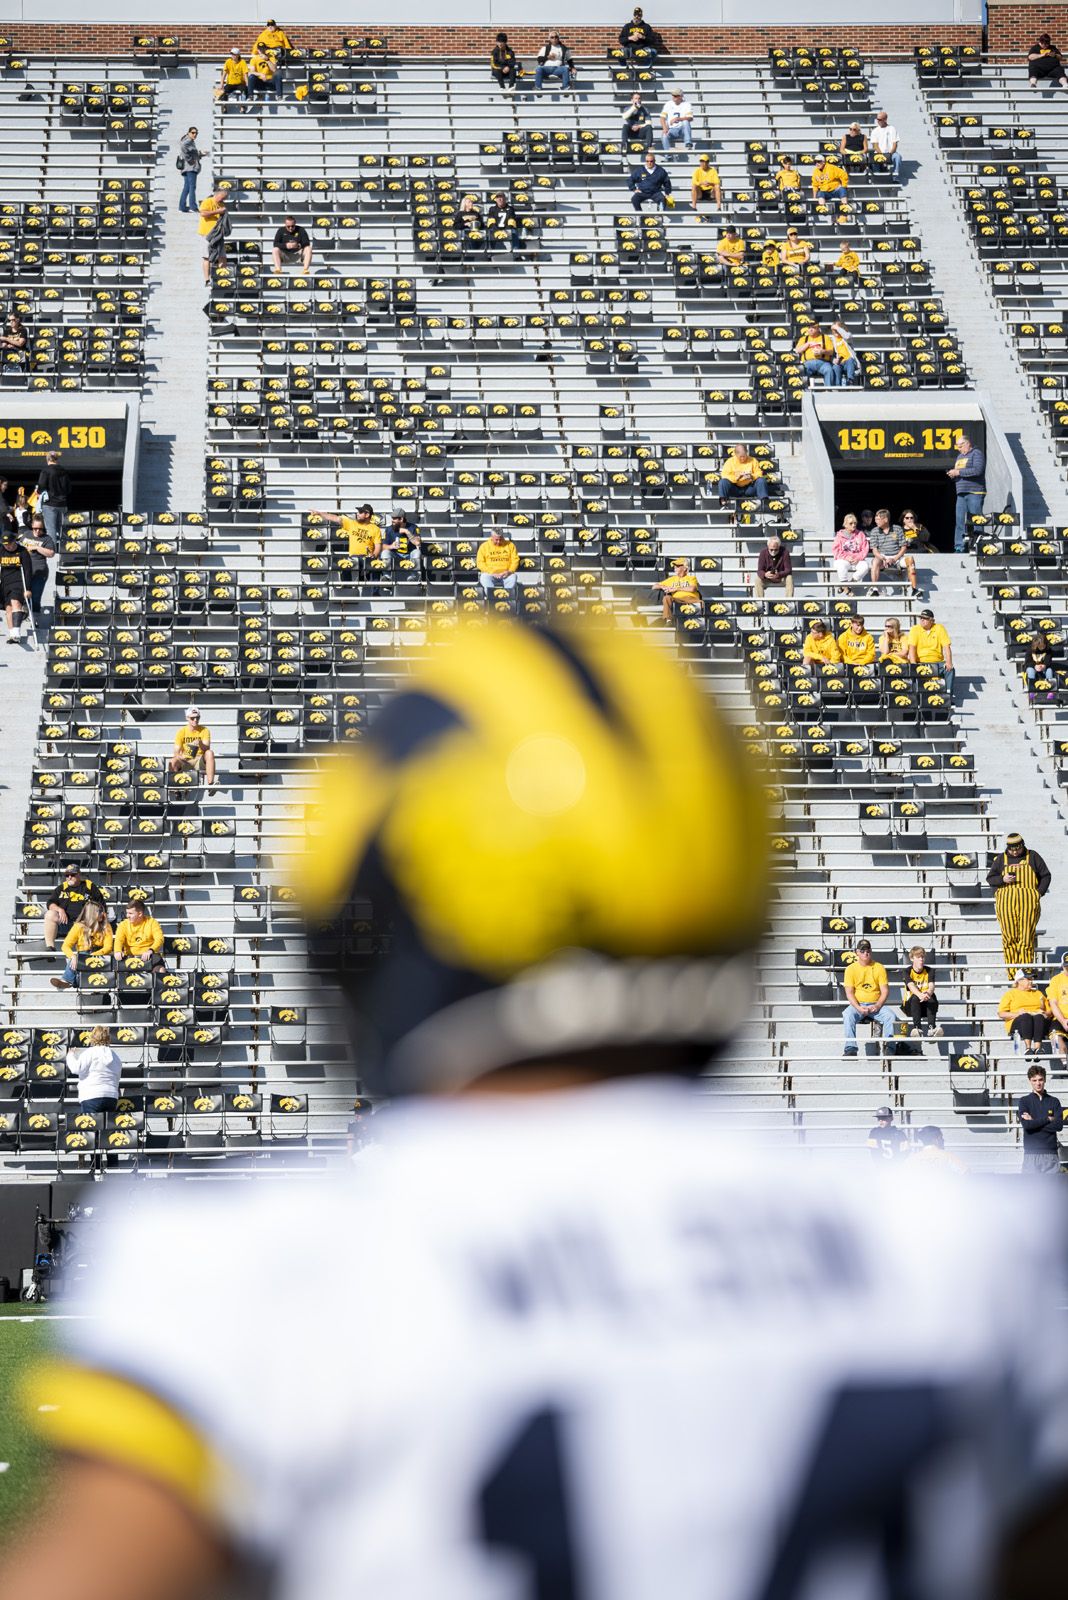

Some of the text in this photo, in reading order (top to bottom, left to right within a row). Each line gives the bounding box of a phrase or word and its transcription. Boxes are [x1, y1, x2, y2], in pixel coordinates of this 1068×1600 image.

[497, 212, 507, 228] 7
[57, 426, 106, 449] 130
[838, 428, 886, 451] 130
[921, 428, 964, 451] 131
[0, 556, 21, 565] IOWA
[847, 640, 866, 648] IOWA
[880, 1139, 894, 1160] 5
